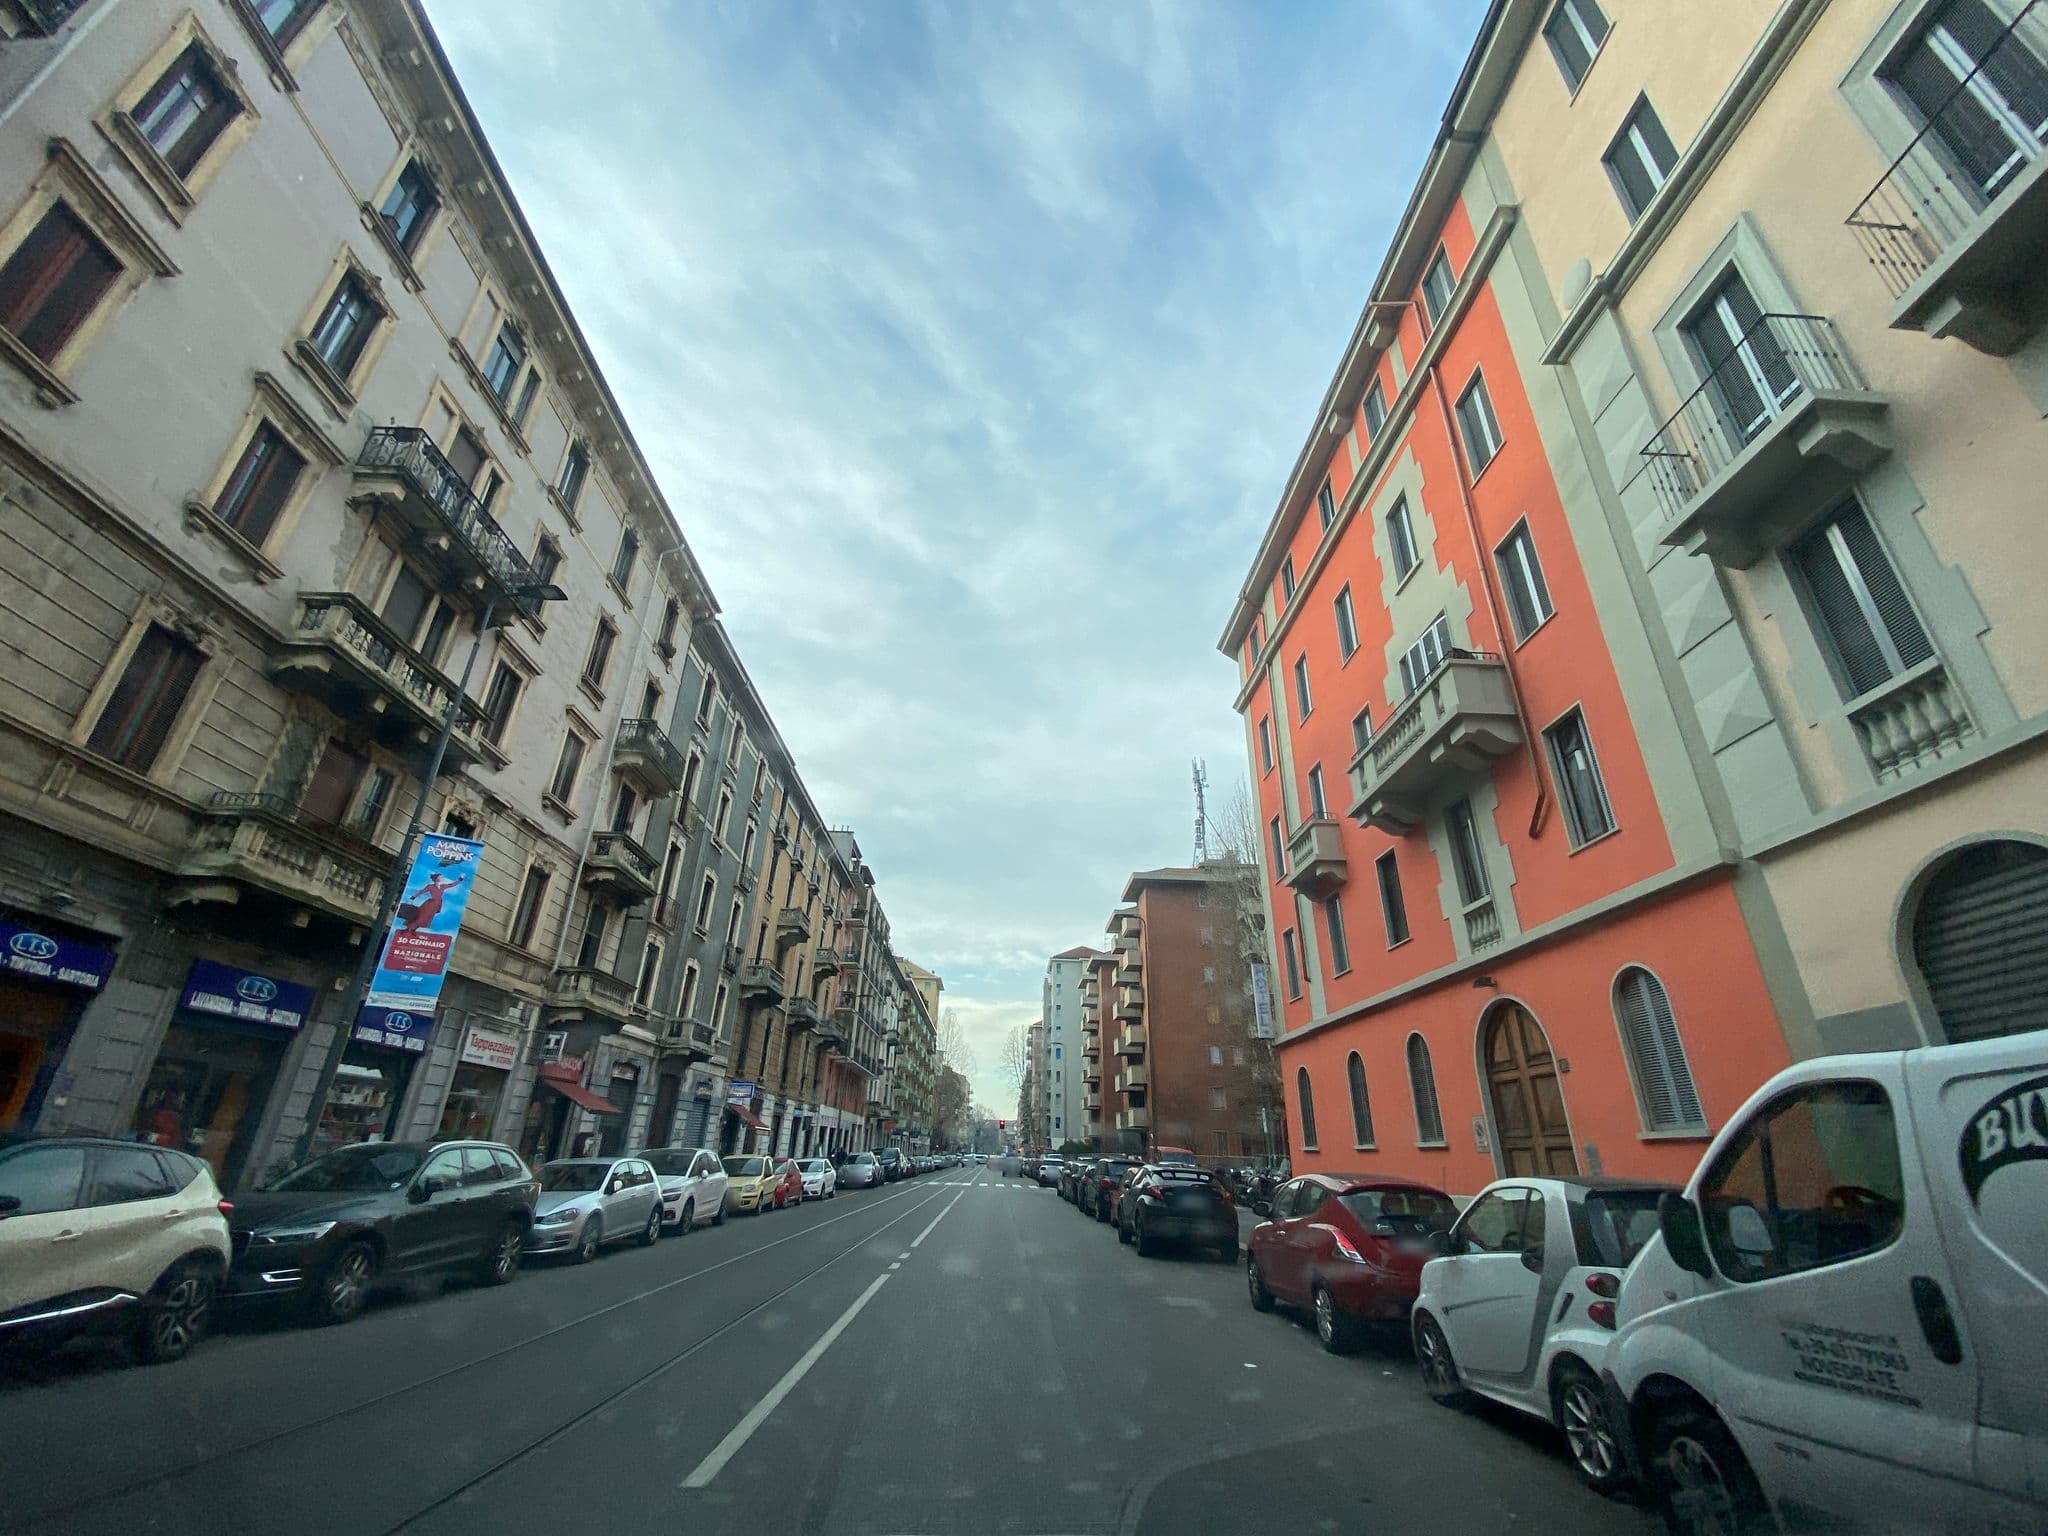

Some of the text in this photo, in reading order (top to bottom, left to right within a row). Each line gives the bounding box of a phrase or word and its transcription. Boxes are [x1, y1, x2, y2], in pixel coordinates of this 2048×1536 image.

[436, 841, 469, 852] MARY
[426, 845, 474, 862] POPPINS
[396, 936, 446, 949] 30 GENNAIO
[393, 949, 442, 960] NAZIONALE
